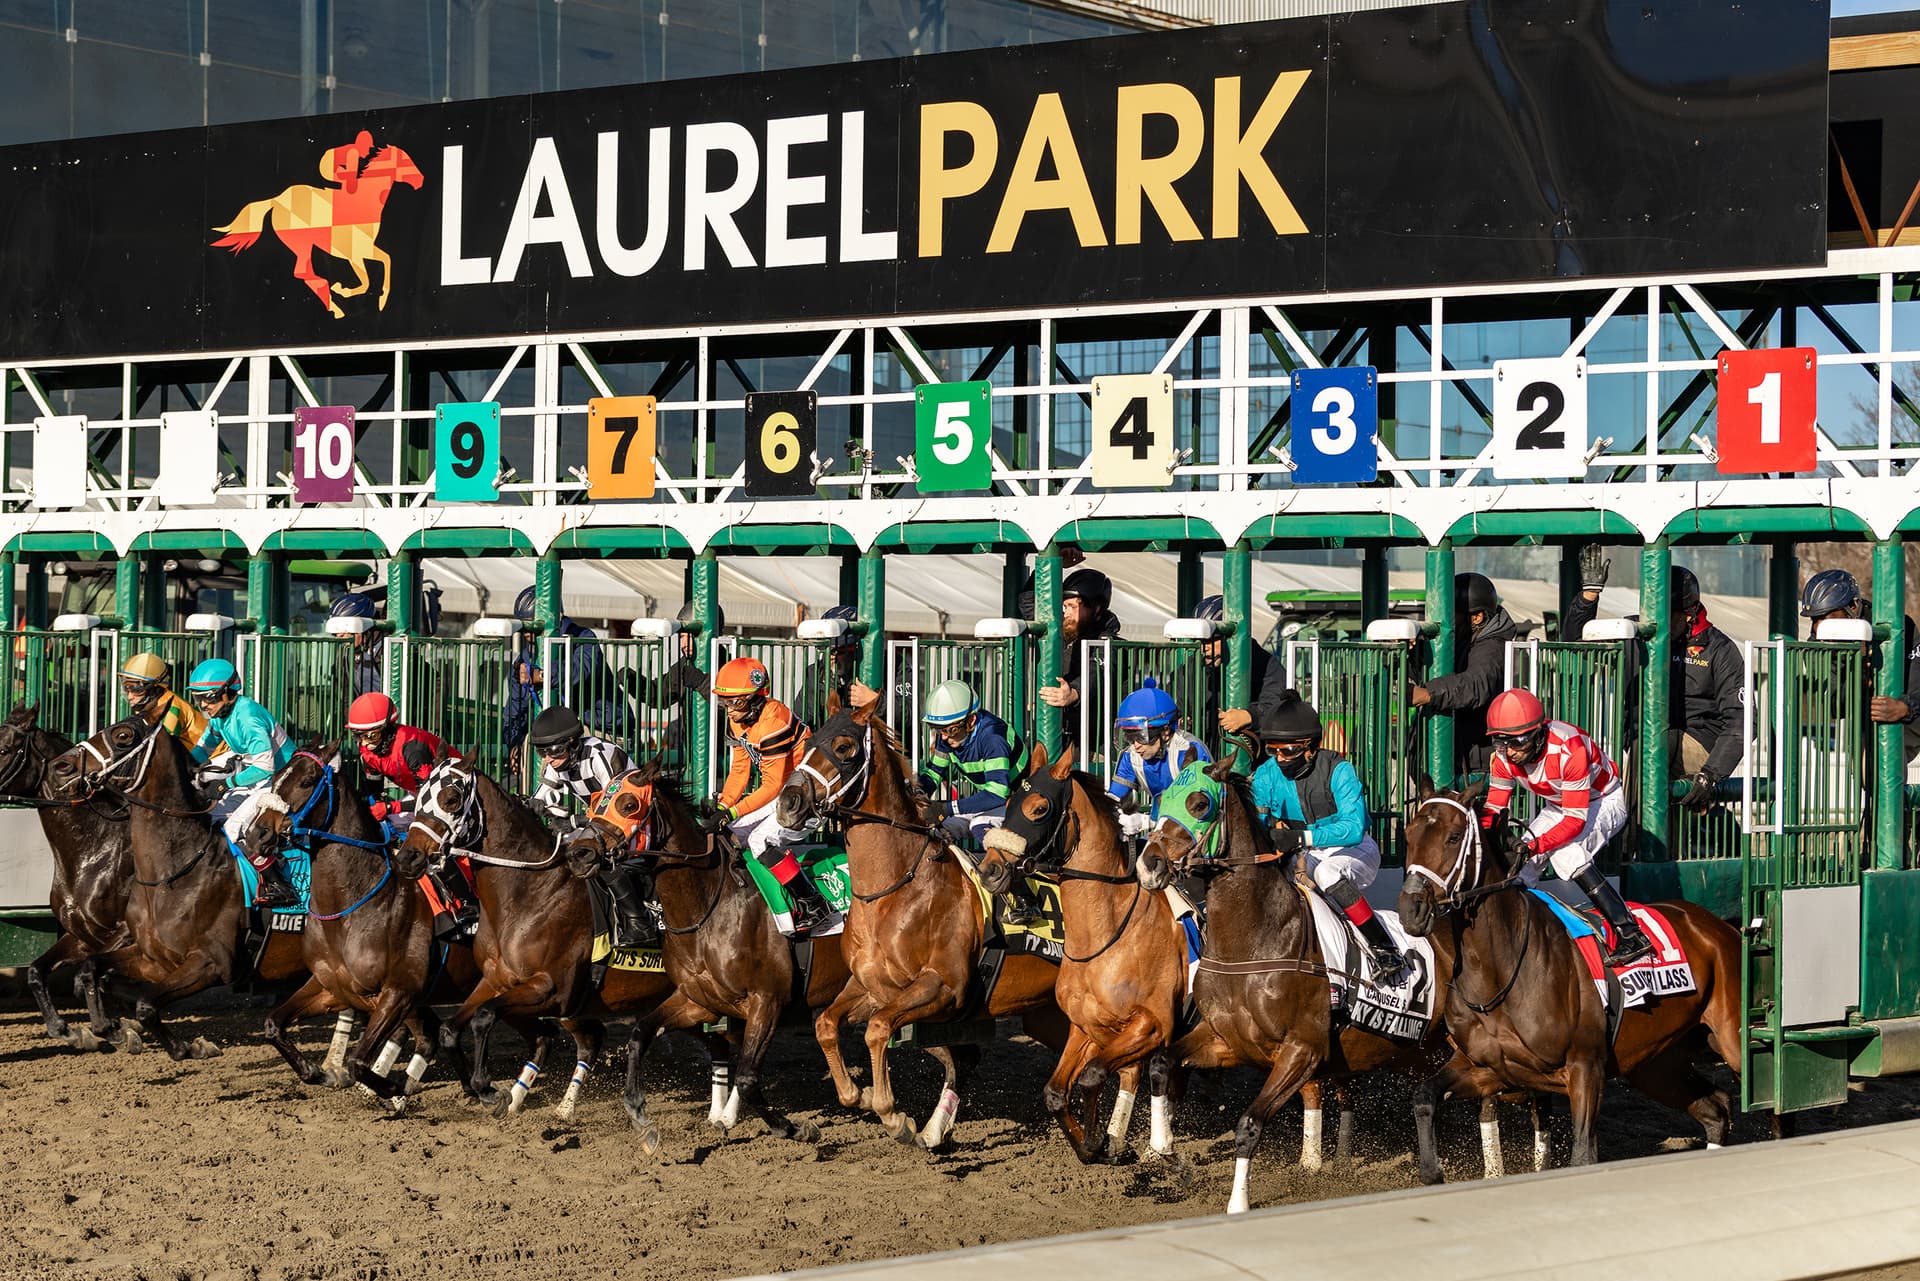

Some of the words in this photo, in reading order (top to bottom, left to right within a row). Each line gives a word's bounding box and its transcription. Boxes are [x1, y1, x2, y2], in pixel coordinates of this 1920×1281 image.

[441, 110, 898, 286] LAUREL
[918, 69, 1313, 258] PARK
[932, 401, 974, 465] 5
[1109, 397, 1155, 460] 4
[1310, 386, 1358, 456] 3
[1515, 381, 1566, 451] 2
[1747, 372, 1782, 444] 1
[295, 422, 354, 480] 10
[450, 421, 485, 479] 9
[604, 416, 639, 475] 7
[760, 411, 801, 474] 6
[1037, 885, 1065, 939] 4
[1631, 908, 1681, 962] 1
[1403, 948, 1429, 1016] 2
[1381, 1013, 1424, 1040] FALLING
